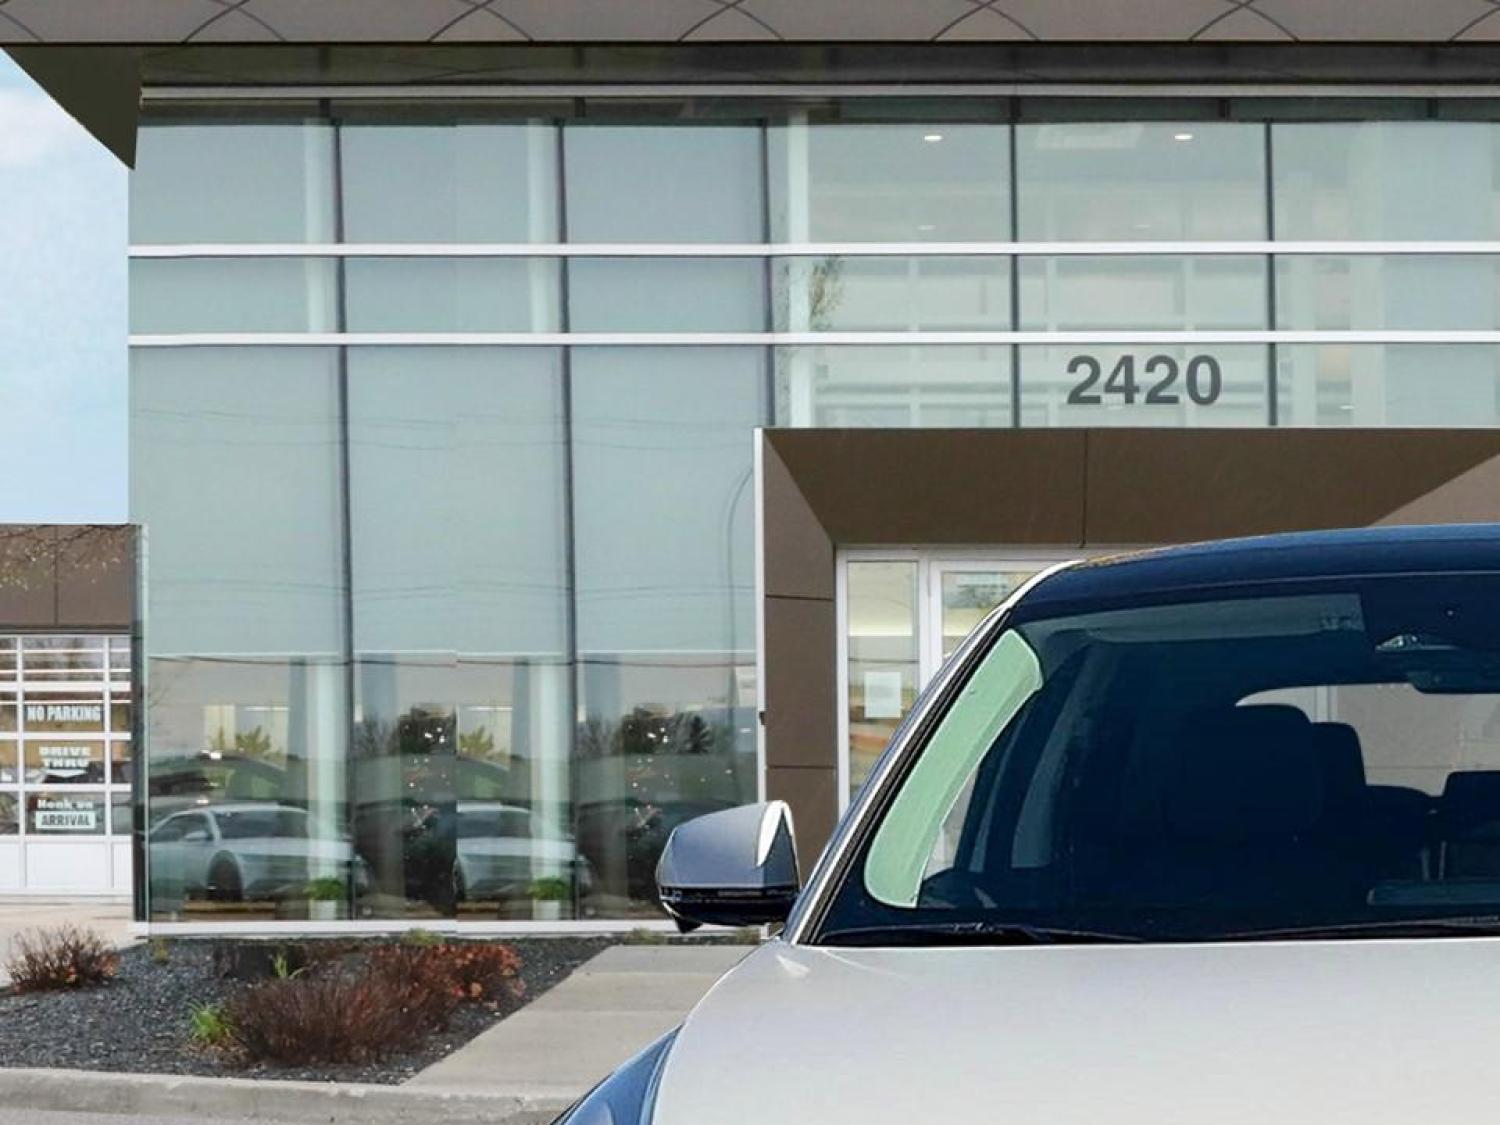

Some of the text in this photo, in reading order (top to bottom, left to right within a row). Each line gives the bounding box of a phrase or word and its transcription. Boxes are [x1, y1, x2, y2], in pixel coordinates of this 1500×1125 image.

[1066, 354, 1222, 406] 2420
[27, 705, 101, 721] NO PARKING
[41, 813, 91, 826] ARRIVAL
